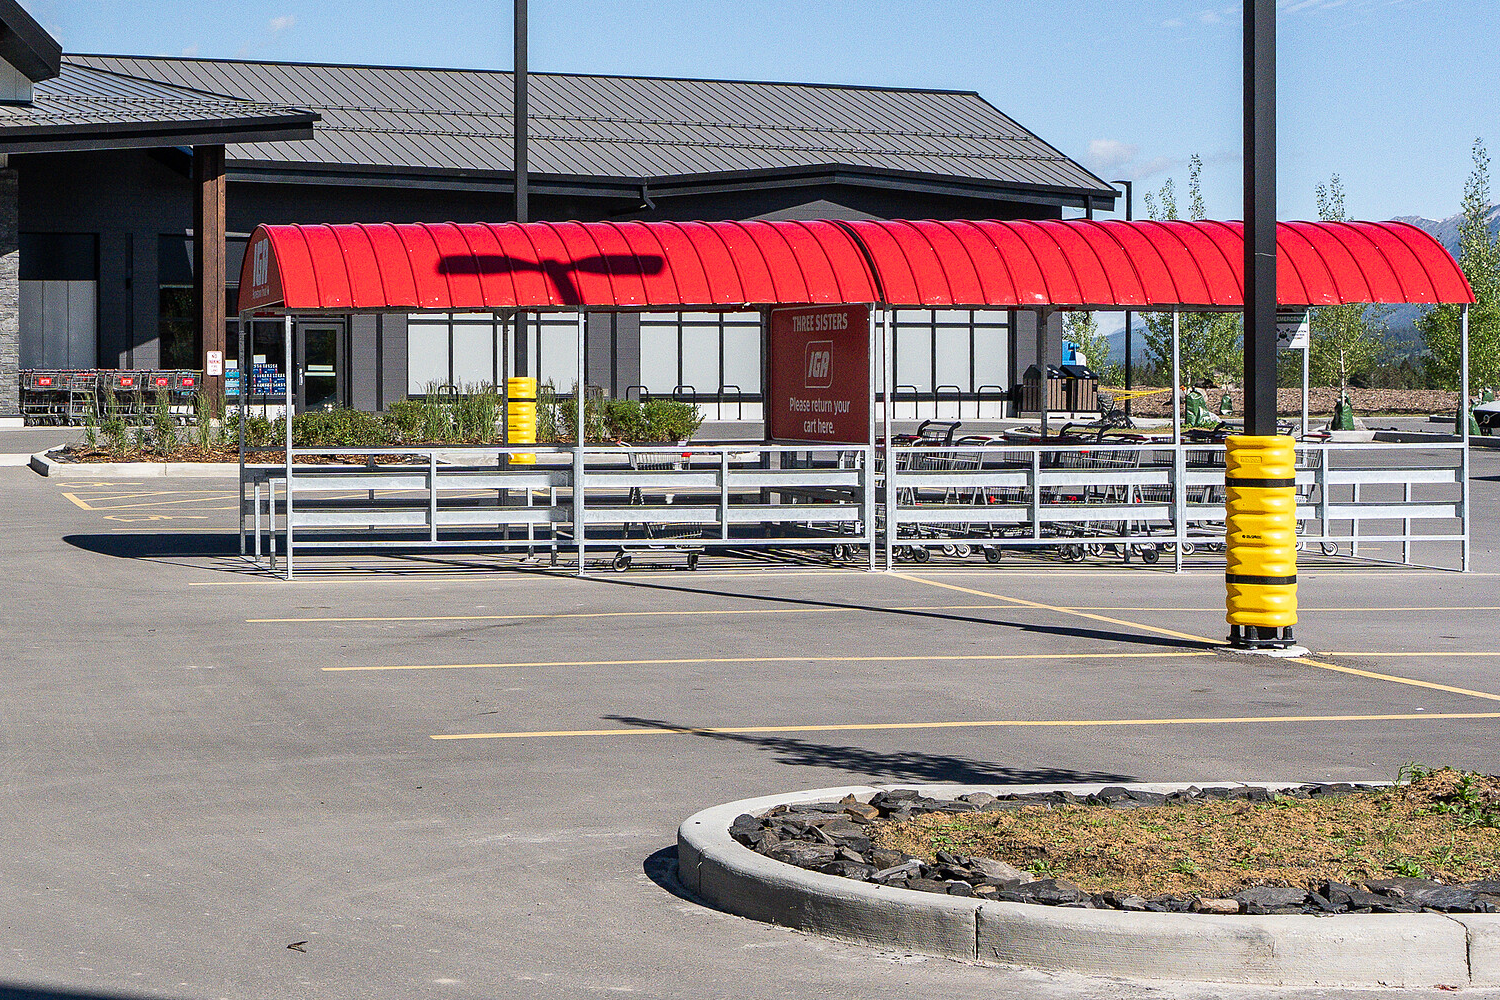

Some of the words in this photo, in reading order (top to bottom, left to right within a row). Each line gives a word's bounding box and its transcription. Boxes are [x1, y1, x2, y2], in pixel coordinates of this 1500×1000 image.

[253, 238, 269, 287] IGA
[793, 315, 814, 332] THREE
[815, 313, 848, 331] SISTERS
[808, 351, 830, 378] IGA
[789, 397, 810, 412] Please
[811, 398, 833, 412] return
[833, 400, 851, 416] your
[803, 419, 817, 434] cart
[817, 418, 835, 435] here.
